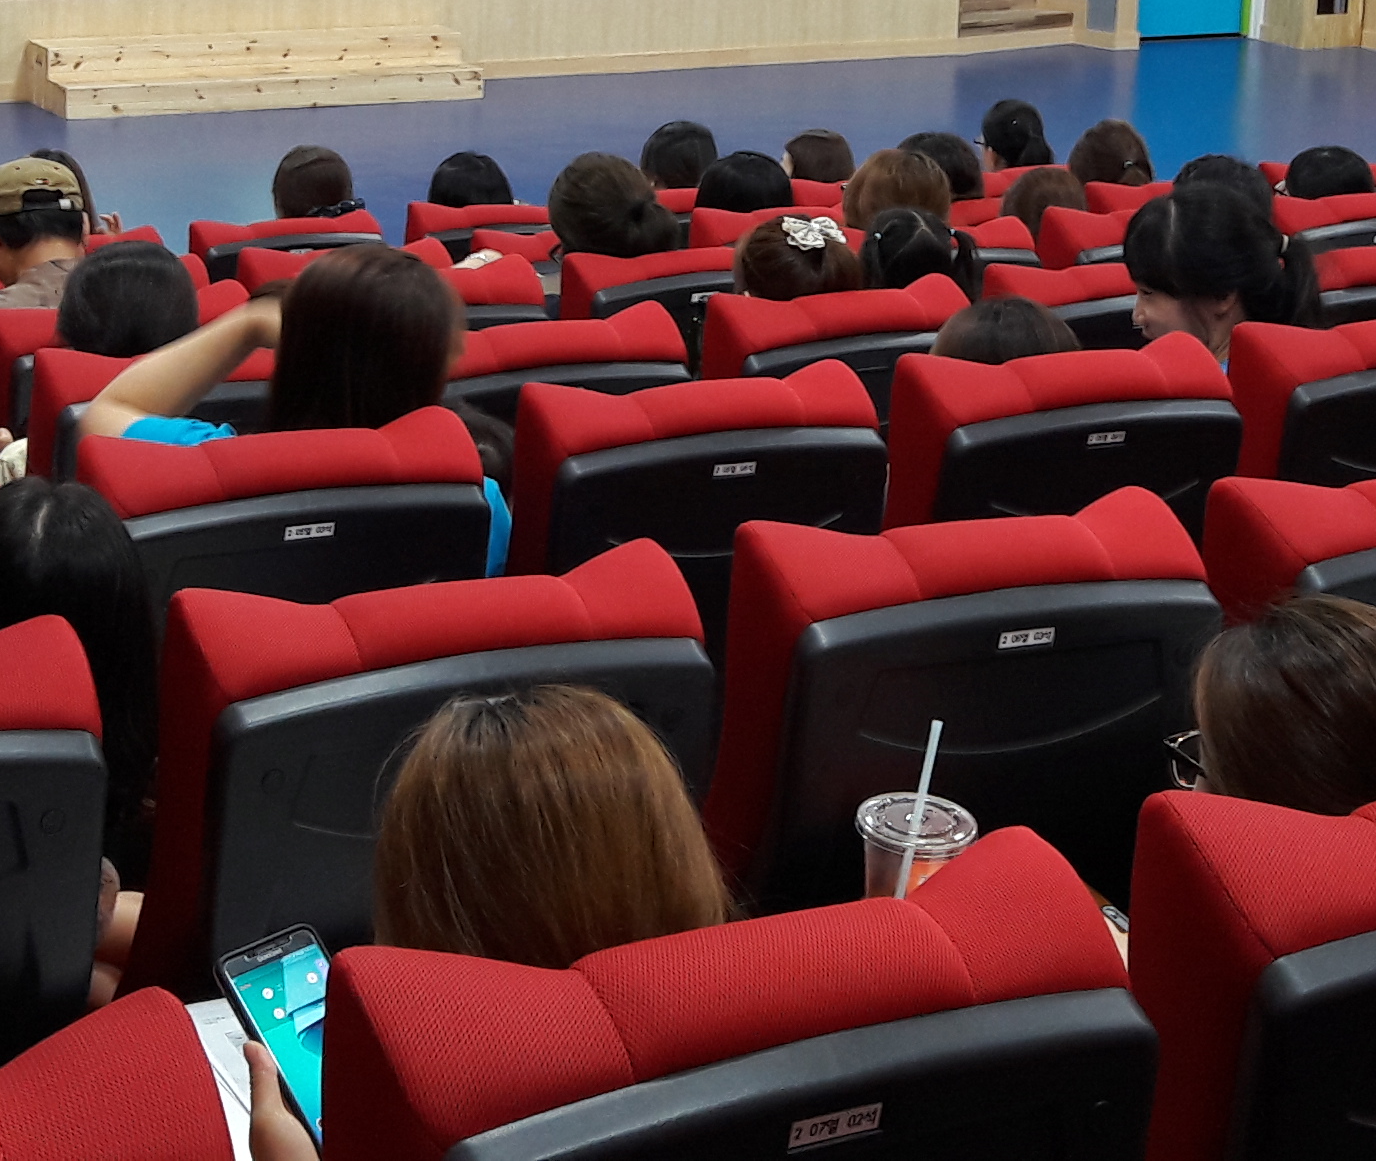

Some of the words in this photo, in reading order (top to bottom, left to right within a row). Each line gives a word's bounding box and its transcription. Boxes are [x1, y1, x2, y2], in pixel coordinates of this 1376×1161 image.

[794, 1127, 803, 1140] 2
[810, 1118, 840, 1137] 07열
[847, 1108, 878, 1128] 02석
